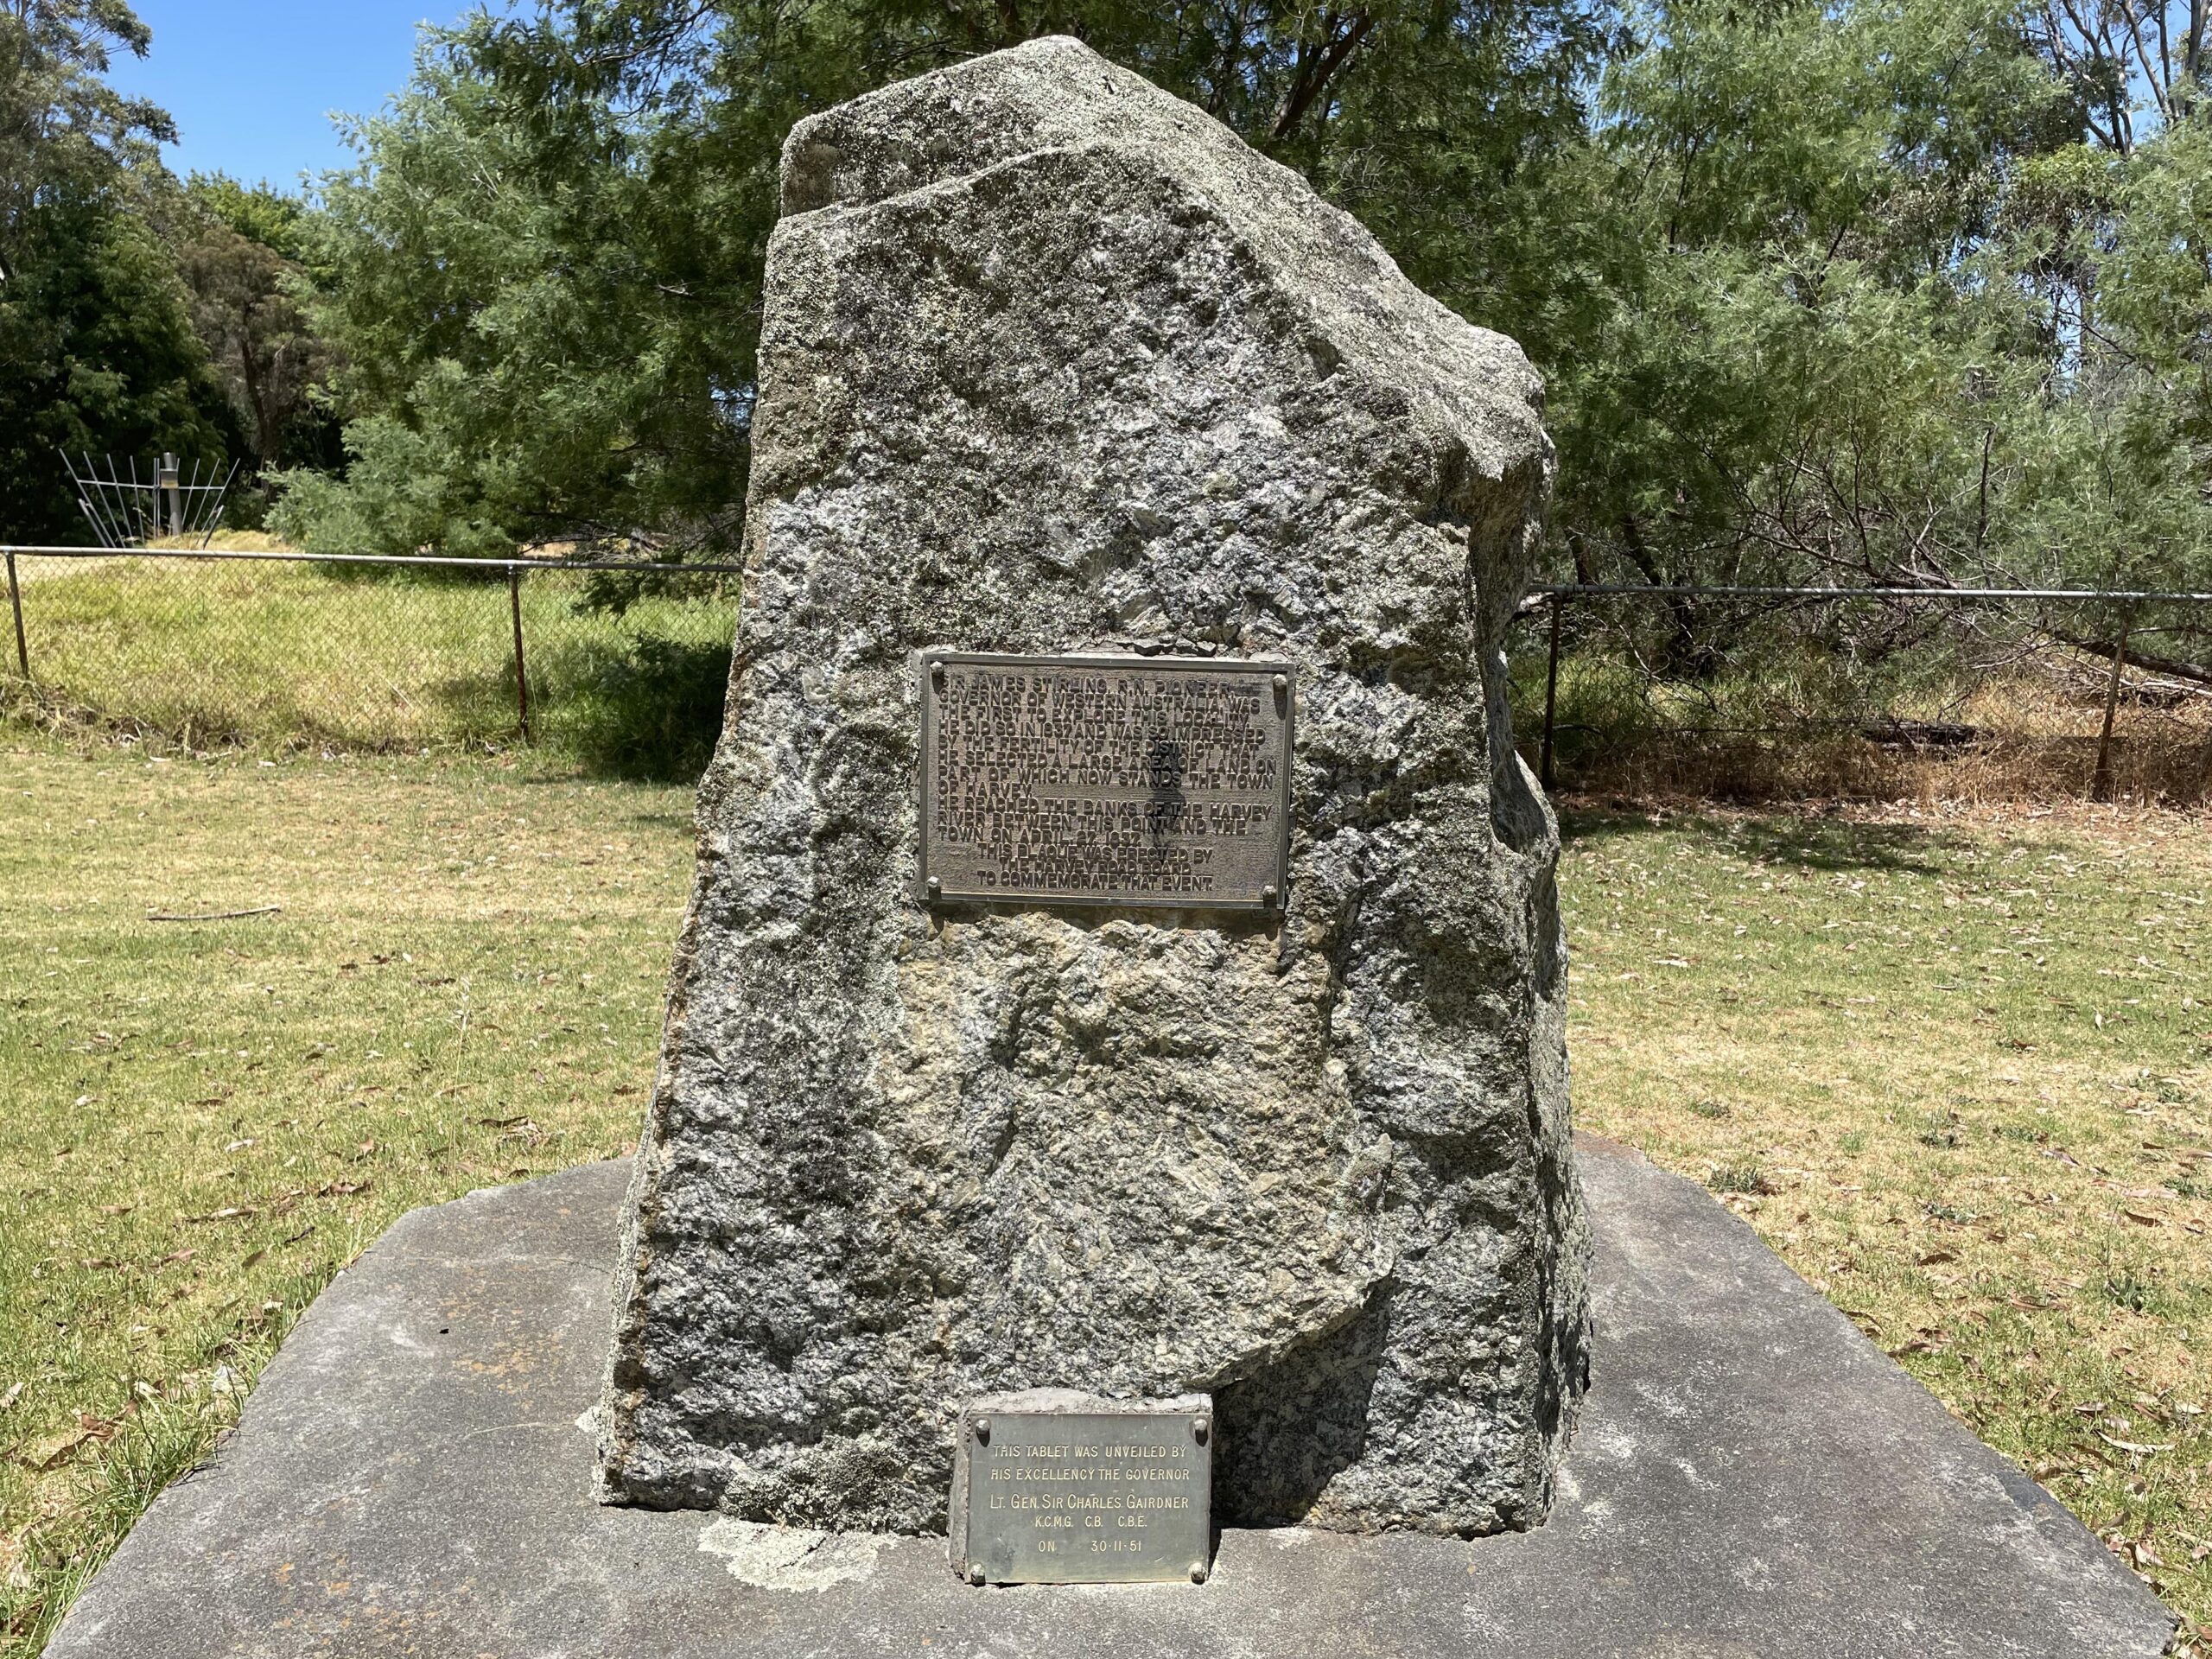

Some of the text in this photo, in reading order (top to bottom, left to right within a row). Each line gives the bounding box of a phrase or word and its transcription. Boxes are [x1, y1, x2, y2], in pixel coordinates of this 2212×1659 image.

[971, 674, 1027, 691] JAMES
[1118, 679, 1148, 696] R.N.
[939, 688, 1022, 706] GOVERNOR
[1027, 691, 1047, 707] OF
[1052, 693, 1126, 710] WESTERN
[1229, 697, 1261, 715] WAS
[939, 704, 969, 721] THE
[977, 705, 1021, 722] FIRST
[1027, 707, 1047, 723] TO
[1052, 708, 1124, 725] EXPLORE
[1132, 710, 1167, 726] THIS
[938, 719, 1266, 745] HE DID SO IN 1837 AND WAS SO IMPRESSED
[938, 734, 1259, 760] BY THE FERTILITY OF THE DISTRICT THAT
[938, 750, 1277, 775] HE SELECTED A LARGE AREA OF LAND ON
[938, 764, 1274, 790] PART OF WHICH NOW STANDS THE TOWN
[938, 779, 959, 795] OF
[938, 795, 1273, 821] HE REACHED THE BANKS OF THE HARVEY
[938, 810, 1248, 836] RIVER BETWEEN THIS POINT AND THE
[938, 826, 983, 842] TOWN
[991, 827, 1013, 843] ON
[978, 842, 1212, 864] THIS PLAQUE WAS ERECTED BY
[1000, 857, 1192, 876] THE HARVEY ROAD BOARD
[977, 870, 1213, 892] TO COMMEMORATE THAT EVENT.
[993, 1445, 1187, 1458] THIS TABLET WAS UNVEILED BY
[990, 1469, 1190, 1480] HIS EXCELLENCY THE GOVERNOR
[1035, 1516, 1147, 1528] K.C.M.G. C.B. C.B.E.
[1039, 1541, 1055, 1552] ON
